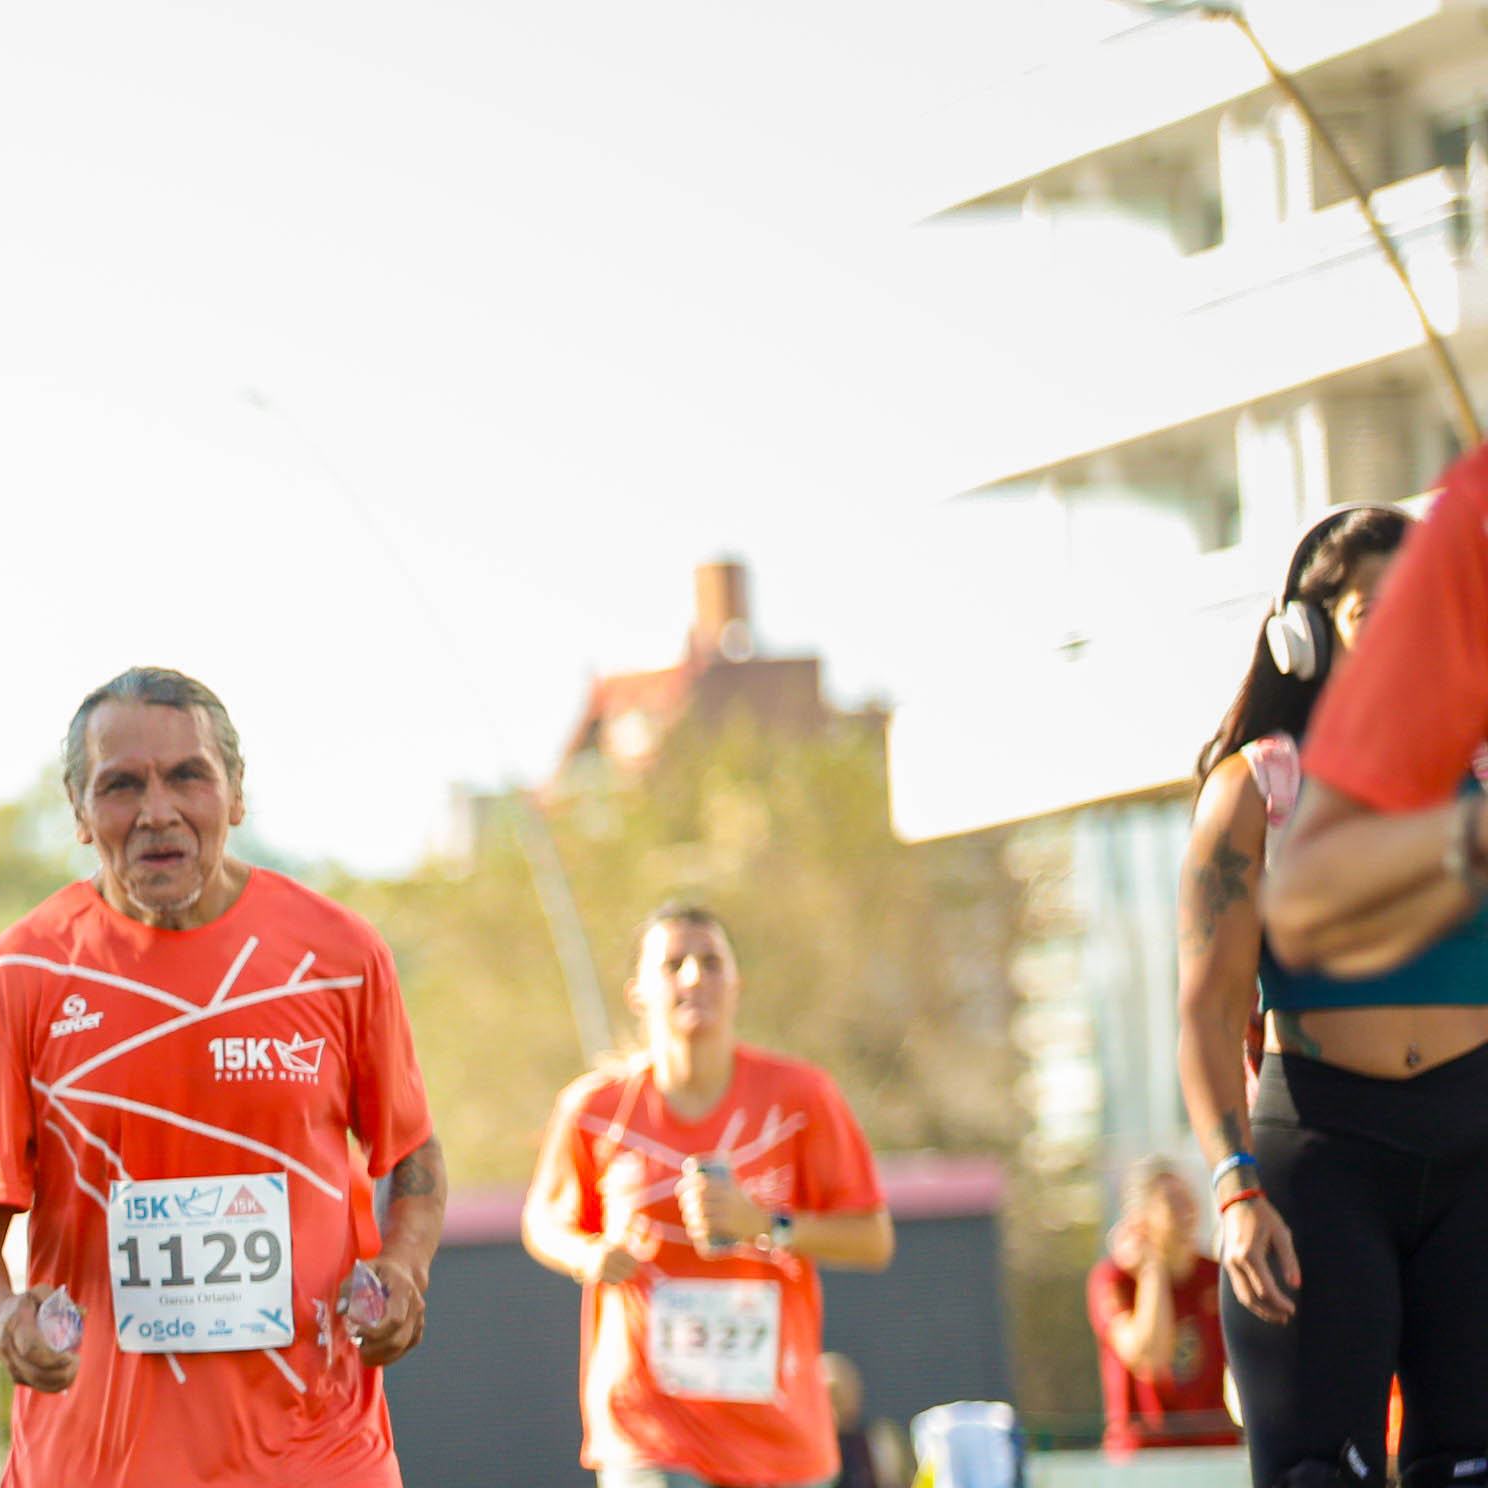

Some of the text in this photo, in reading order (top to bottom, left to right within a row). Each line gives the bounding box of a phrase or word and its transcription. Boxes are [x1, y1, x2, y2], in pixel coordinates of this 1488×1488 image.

[208, 1037, 273, 1071] 15K
[124, 1197, 170, 1220] 15K
[233, 1199, 257, 1213] 15K
[117, 1229, 283, 1288] 1129
[138, 1317, 196, 1338] osde
